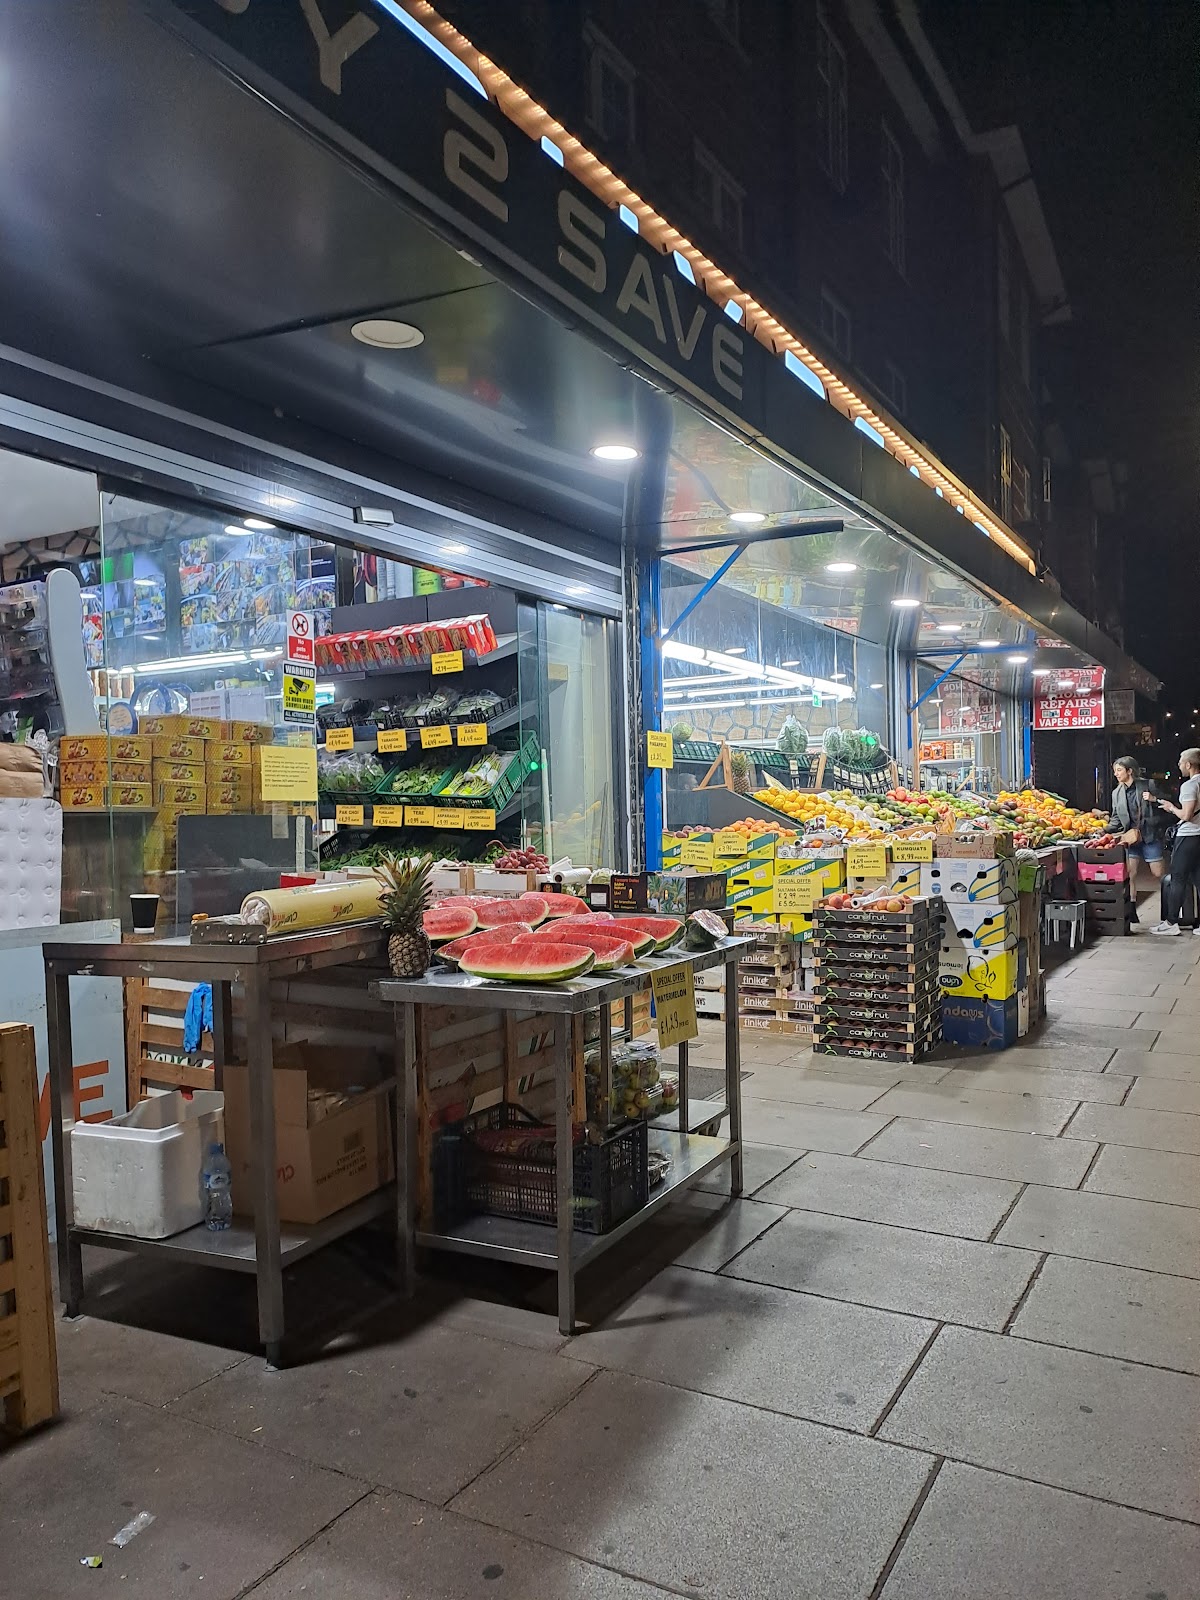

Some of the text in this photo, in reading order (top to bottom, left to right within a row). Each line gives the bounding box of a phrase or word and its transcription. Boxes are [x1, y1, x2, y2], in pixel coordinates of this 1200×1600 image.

[212, 0, 744, 401] Y 2 SAVE
[285, 665, 314, 677] WARNING
[1040, 698, 1098, 709] REPAIRS
[1039, 716, 1099, 727] VAPES SHOP
[656, 971, 686, 986] SPECIAL OFFER
[656, 988, 687, 1004] WATERMELON
